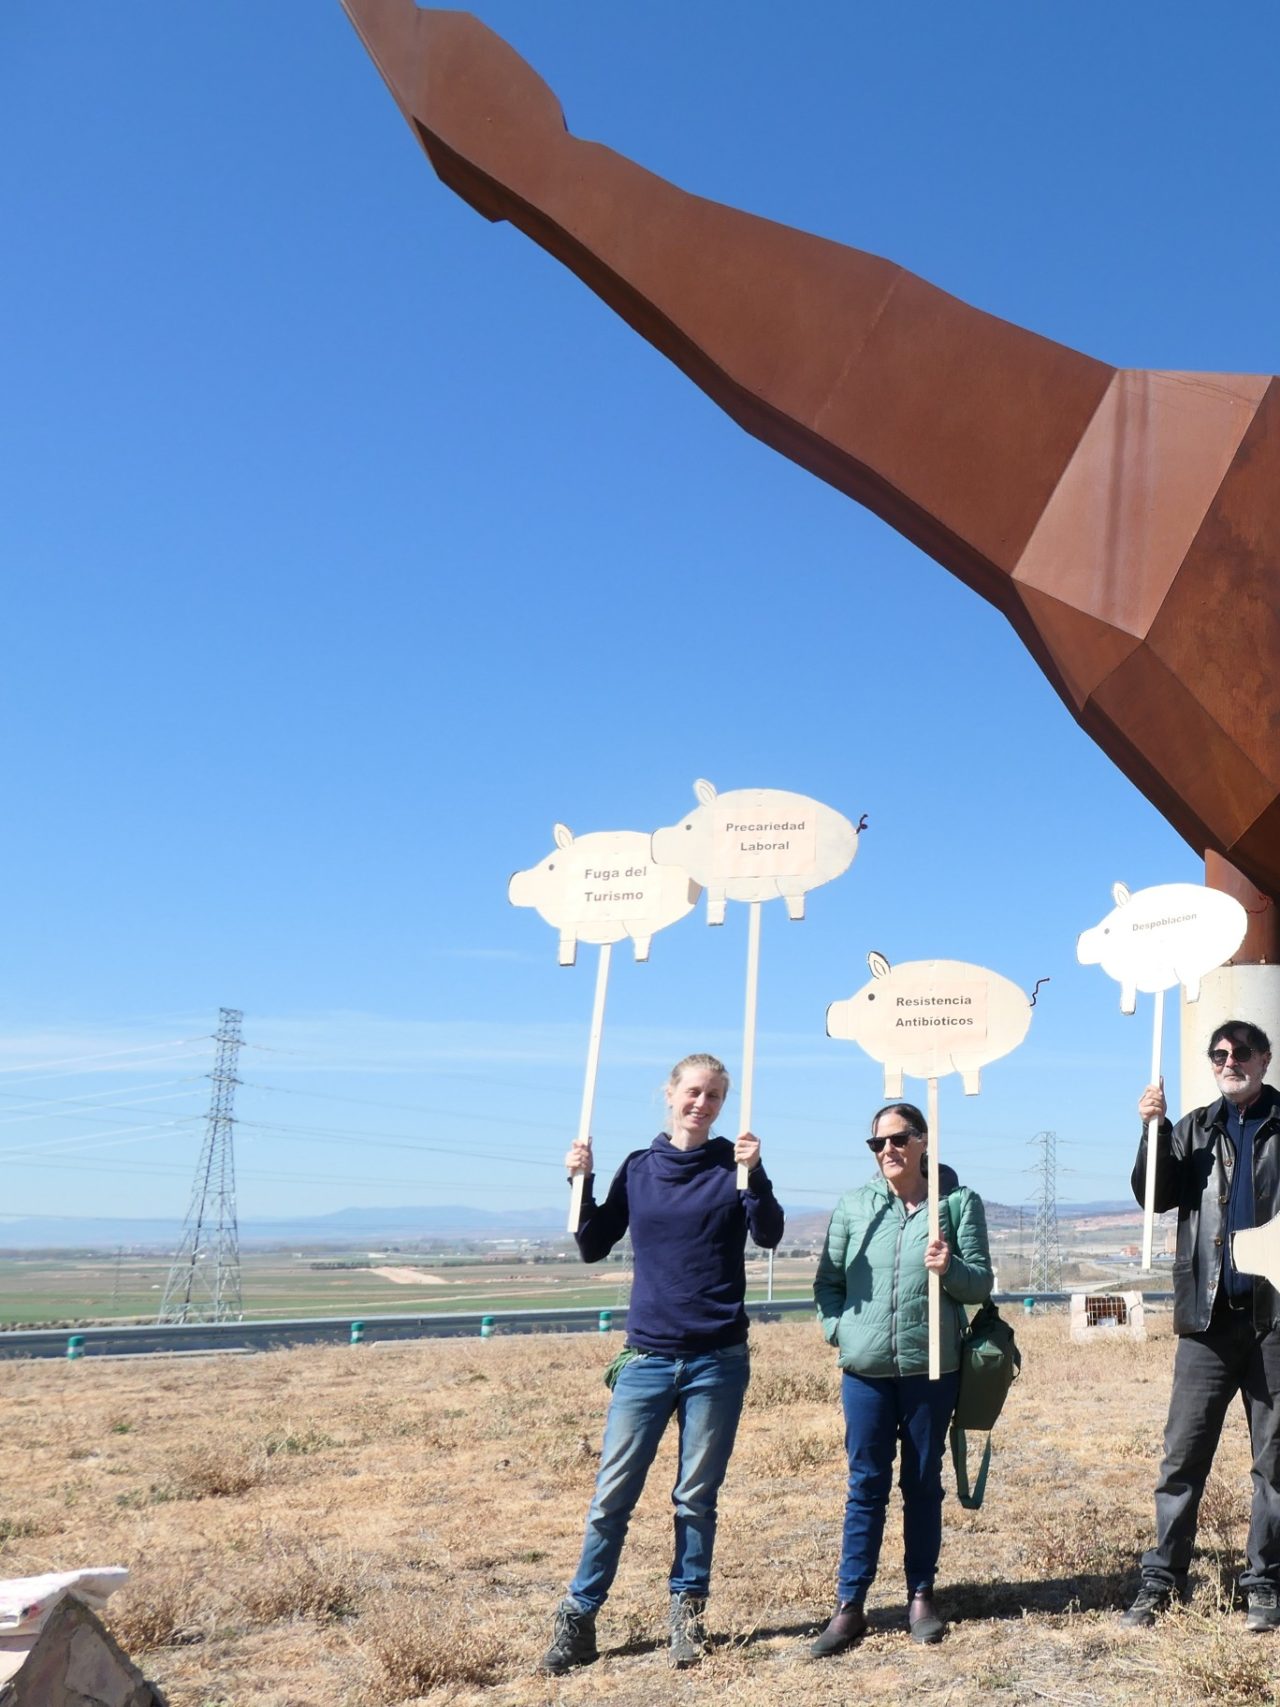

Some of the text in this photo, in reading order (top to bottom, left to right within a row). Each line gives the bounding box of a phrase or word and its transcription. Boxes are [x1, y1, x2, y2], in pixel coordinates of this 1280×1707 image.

[725, 821, 806, 832] Precariedad
[740, 841, 790, 851] Laboral
[584, 865, 648, 881] Fuga del
[583, 890, 644, 902] Turismo
[896, 995, 973, 1007] Resistencia
